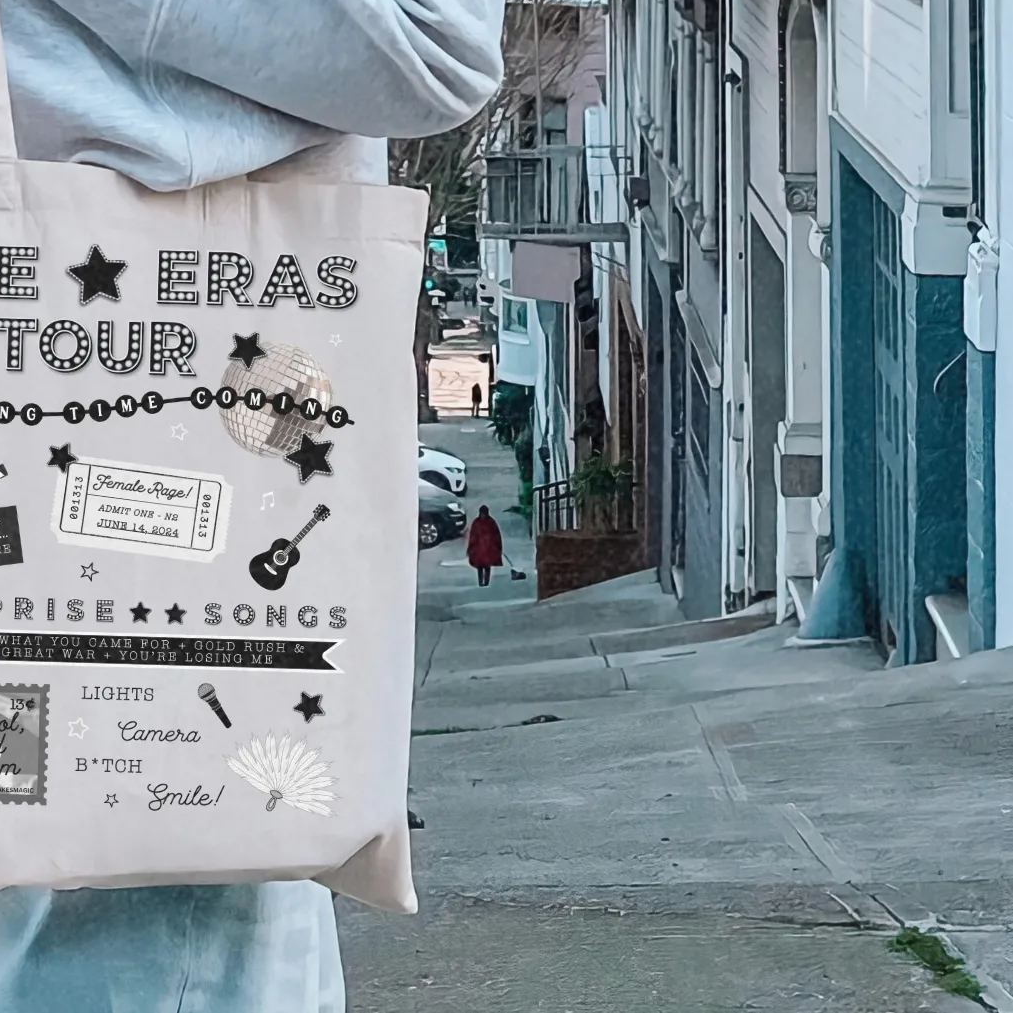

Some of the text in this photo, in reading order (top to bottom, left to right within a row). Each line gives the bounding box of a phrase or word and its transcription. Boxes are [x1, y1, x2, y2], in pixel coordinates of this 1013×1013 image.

[156, 249, 359, 309] ERAS
[68, 394, 158, 422] TIME
[195, 390, 343, 424] COMING
[92, 474, 194, 501] Female Rage!
[98, 504, 132, 516] ADMIT
[133, 508, 154, 519] ONE
[96, 518, 128, 531] JUNE
[151, 525, 179, 538] 2024
[204, 602, 347, 629] SONGS
[1, 647, 55, 659] GREAT
[62, 648, 96, 660] WAR
[119, 650, 177, 662] YOU'RE
[184, 652, 243, 664] LOSING
[250, 653, 274, 665] ME
[50, 636, 81, 647] YOU
[88, 637, 132, 649] CAME
[140, 638, 170, 650] FOR
[194, 640, 236, 651] GOLD
[243, 641, 286, 653] RUSH
[293, 643, 305, 654] &
[81, 686, 154, 702] LIGHTS
[117, 720, 201, 743] Camera
[147, 783, 225, 811] Smile!
